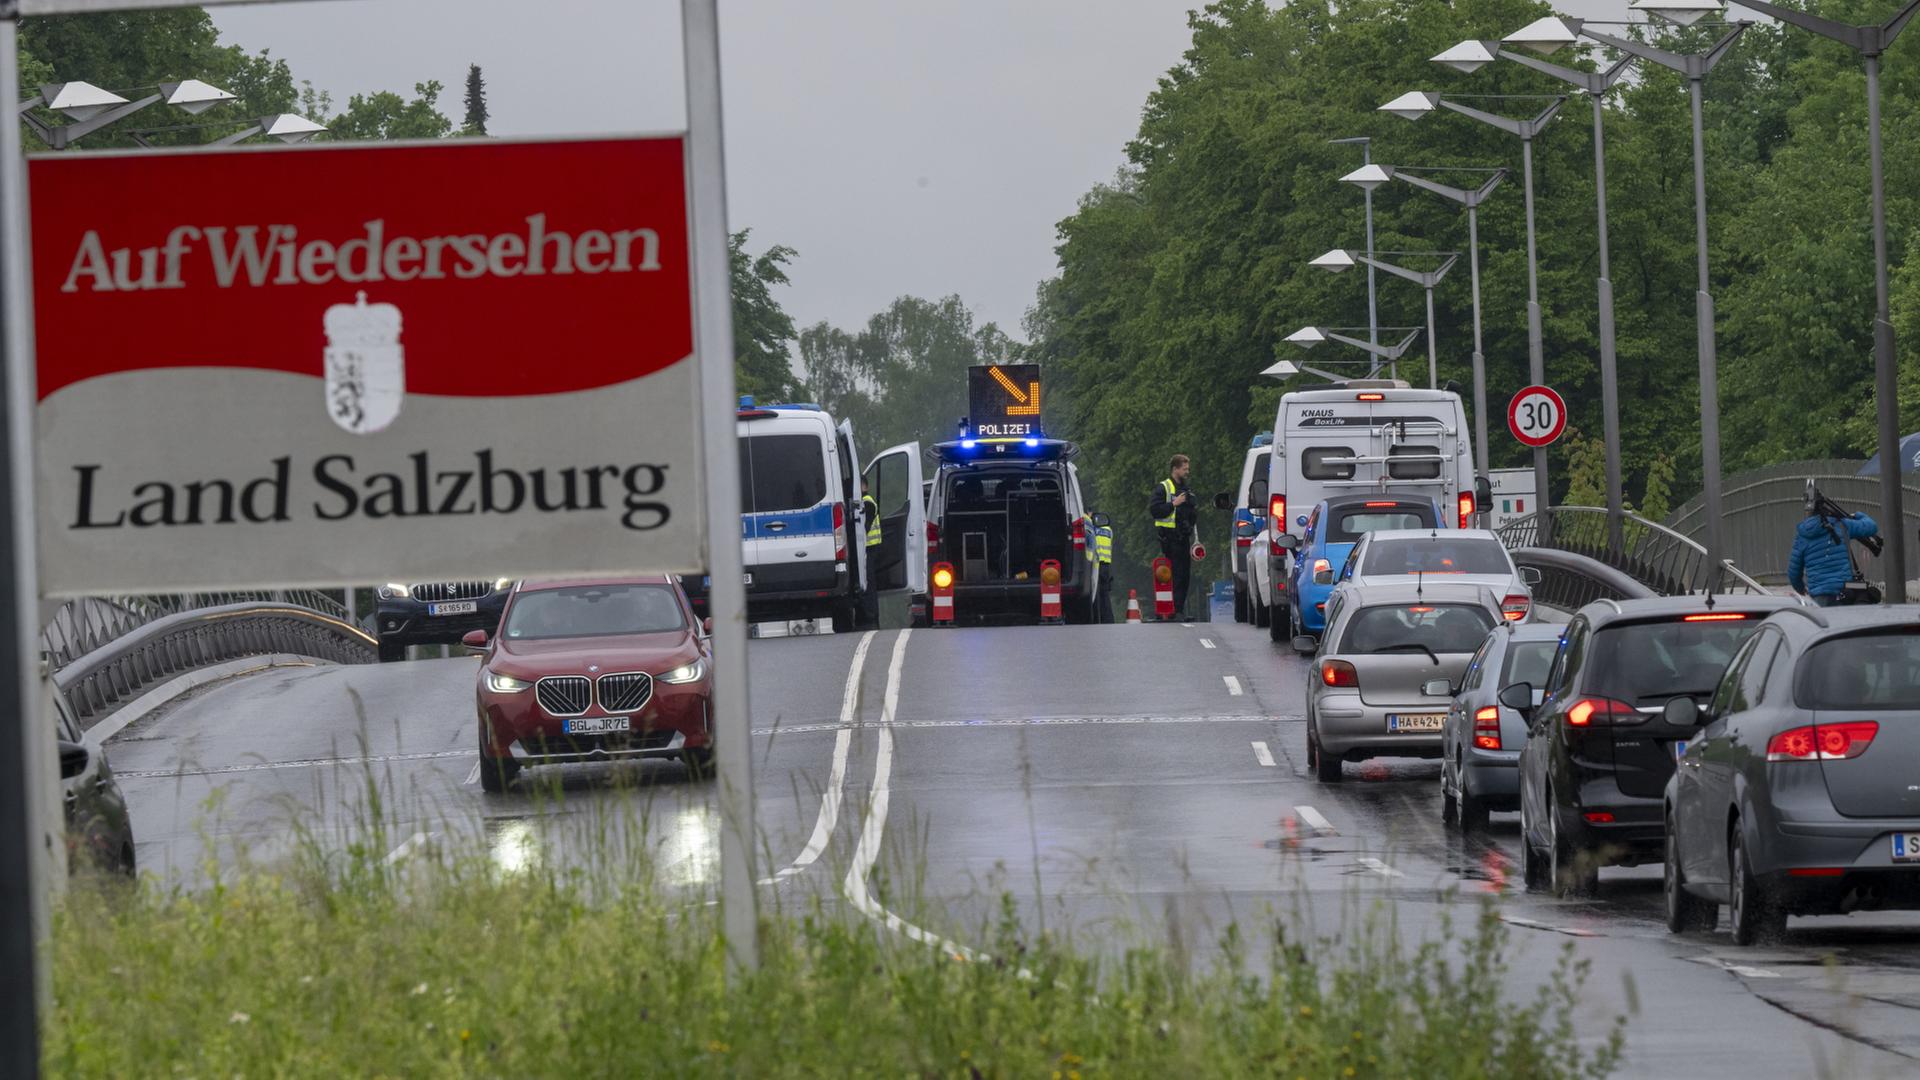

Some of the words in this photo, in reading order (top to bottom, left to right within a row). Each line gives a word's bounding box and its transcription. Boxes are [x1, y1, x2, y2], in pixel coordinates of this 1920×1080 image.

[61, 225, 201, 292] Auf
[202, 212, 662, 288] Wiedersehen
[1301, 409, 1334, 417] KNAUS
[1522, 401, 1552, 430] 30
[1314, 418, 1345, 426] BoxLife
[979, 423, 1031, 435] POLIZEI
[68, 455, 292, 531] Land
[313, 448, 671, 531] Salzburg
[569, 720, 591, 731] BGL
[1399, 716, 1412, 728] HA
